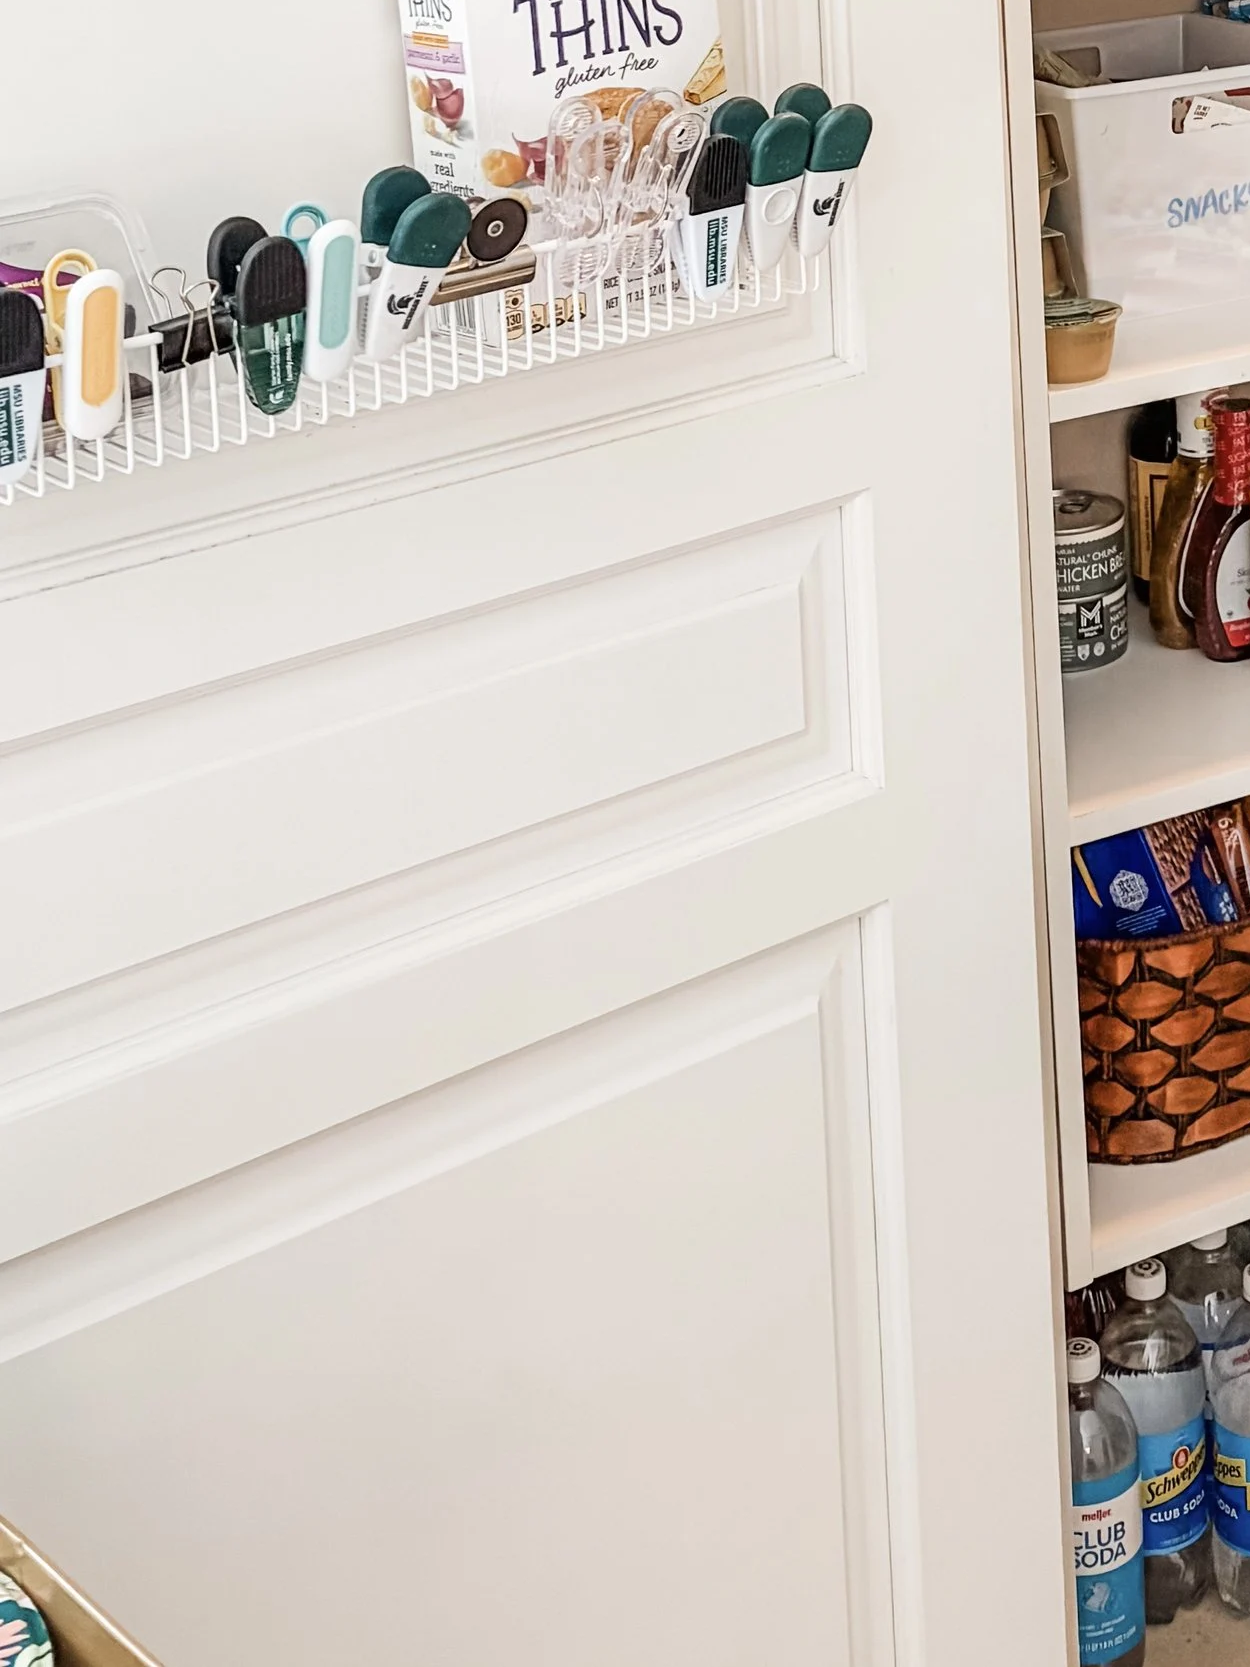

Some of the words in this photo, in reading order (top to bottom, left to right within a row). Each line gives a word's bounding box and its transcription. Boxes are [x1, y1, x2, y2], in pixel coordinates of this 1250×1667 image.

[554, 60, 615, 98] gluten
[619, 52, 659, 80] free
[434, 162, 454, 178] real
[720, 216, 728, 236] MSU
[707, 219, 719, 286] lib.msu.edu
[719, 239, 727, 284] LIBRARIES
[505, 313, 521, 325] 130
[13, 384, 23, 407] MSU
[15, 410, 27, 462] LIBRARIES
[1057, 561, 1108, 584] HICKEN
[1217, 818, 1233, 830] 6
[1081, 1508, 1111, 1522] meijer
[1149, 1504, 1178, 1524] CLUB
